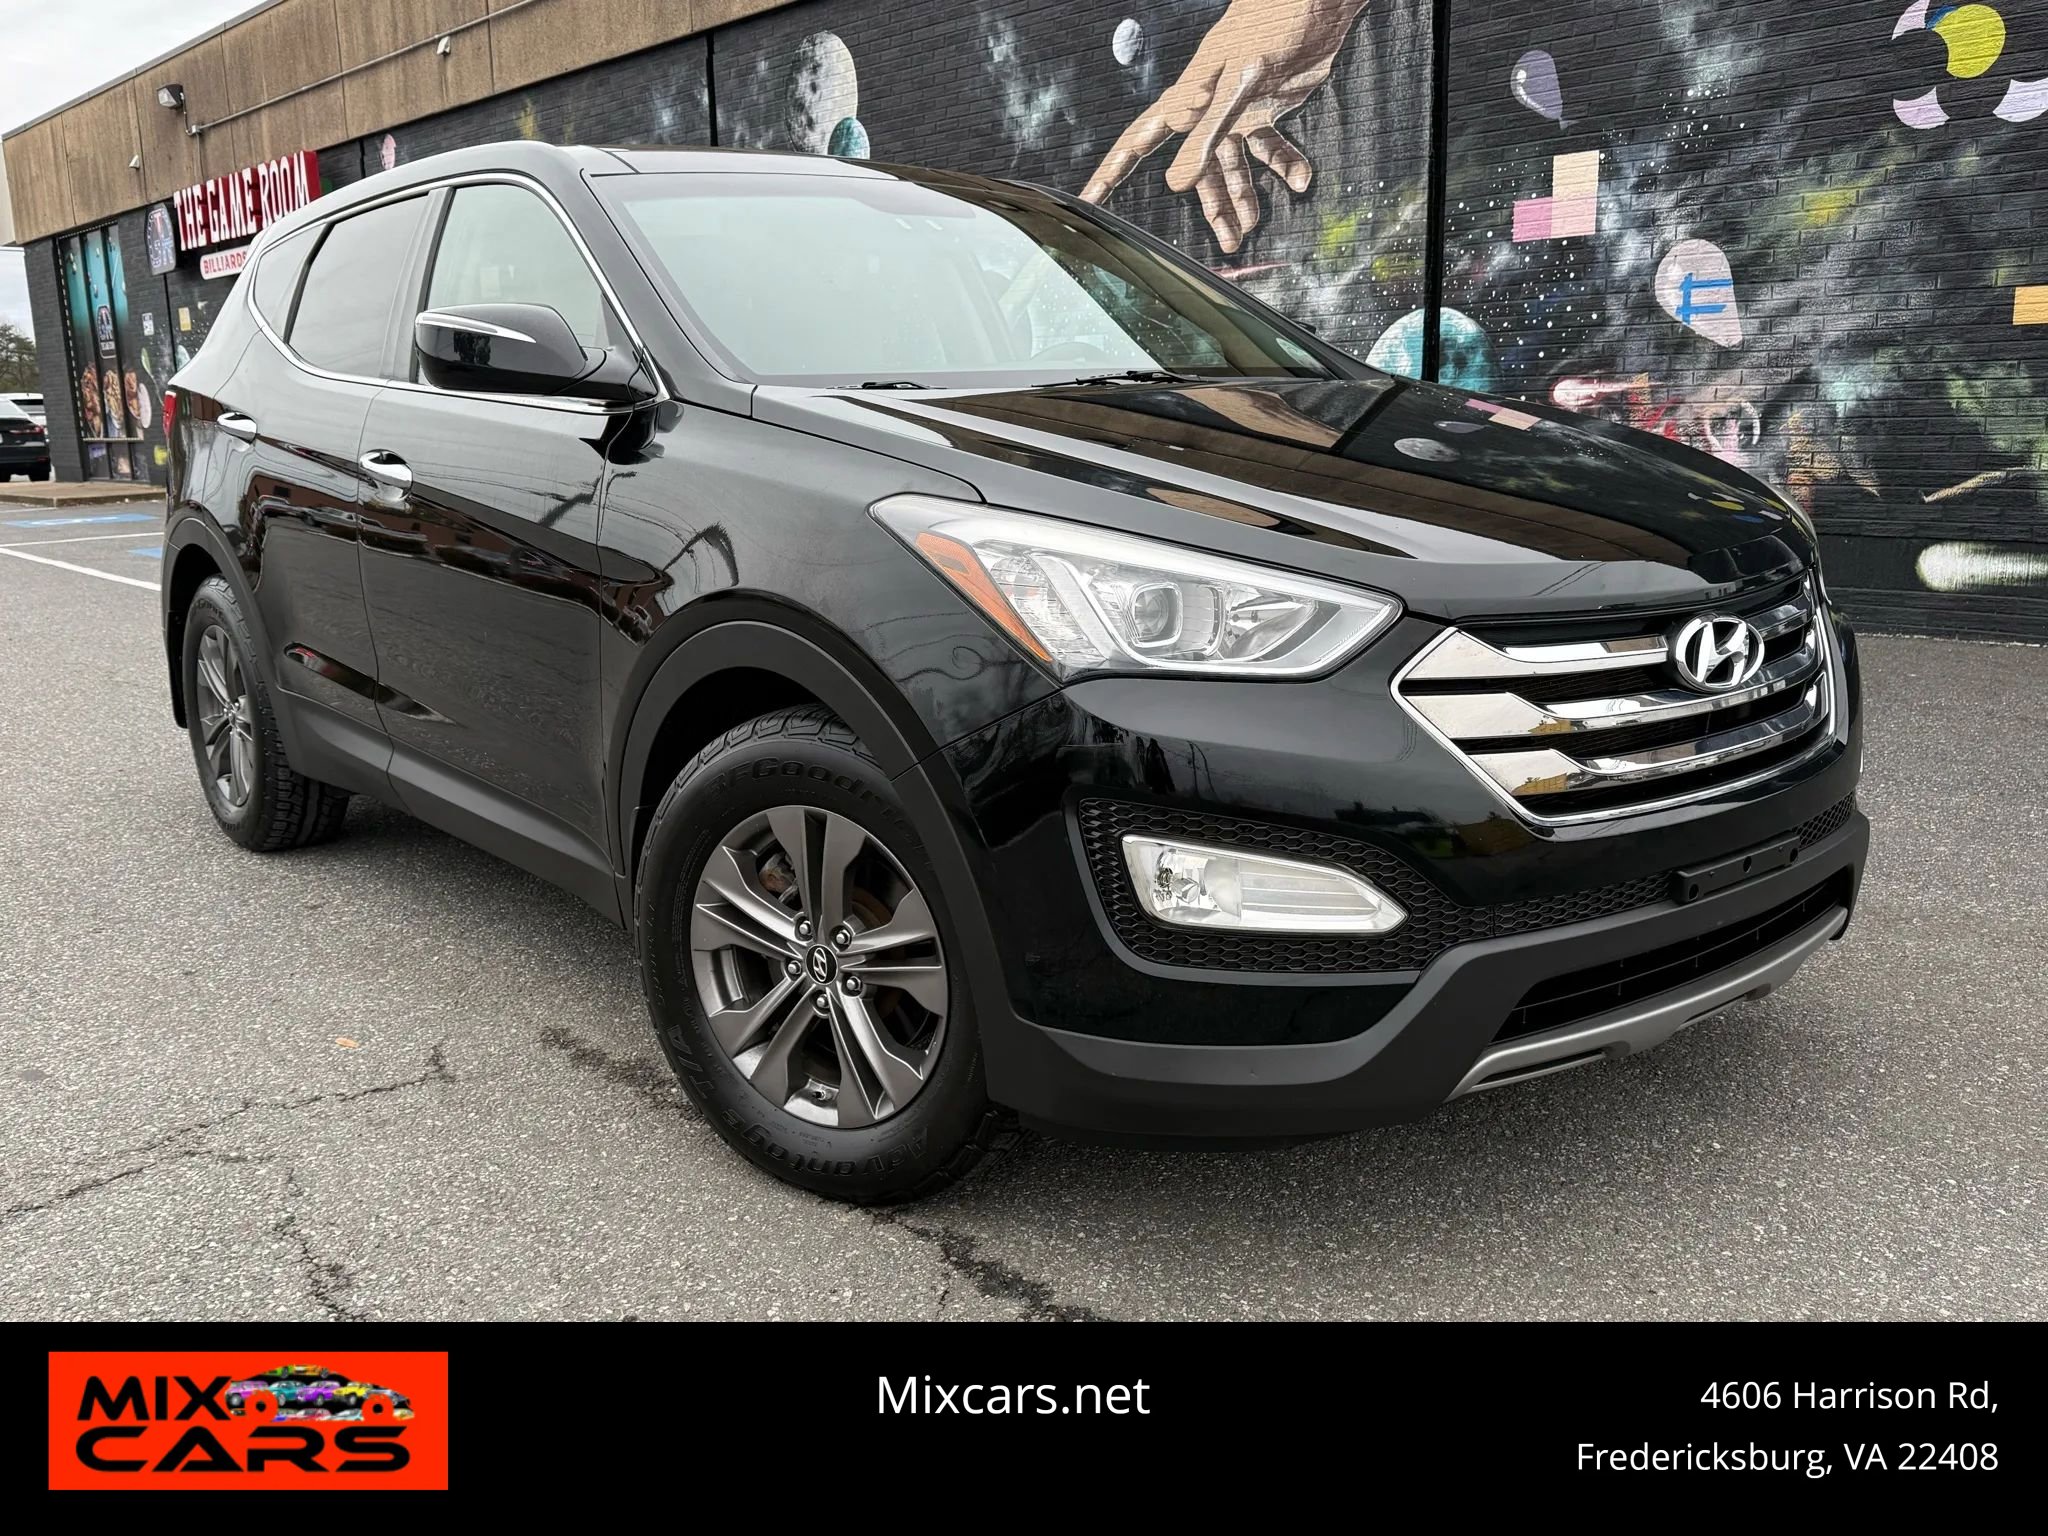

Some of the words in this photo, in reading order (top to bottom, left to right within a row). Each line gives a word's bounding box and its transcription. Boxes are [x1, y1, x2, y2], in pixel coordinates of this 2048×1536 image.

[173, 184, 207, 251] THE
[206, 167, 257, 243] GAME
[257, 150, 311, 229] ROOM
